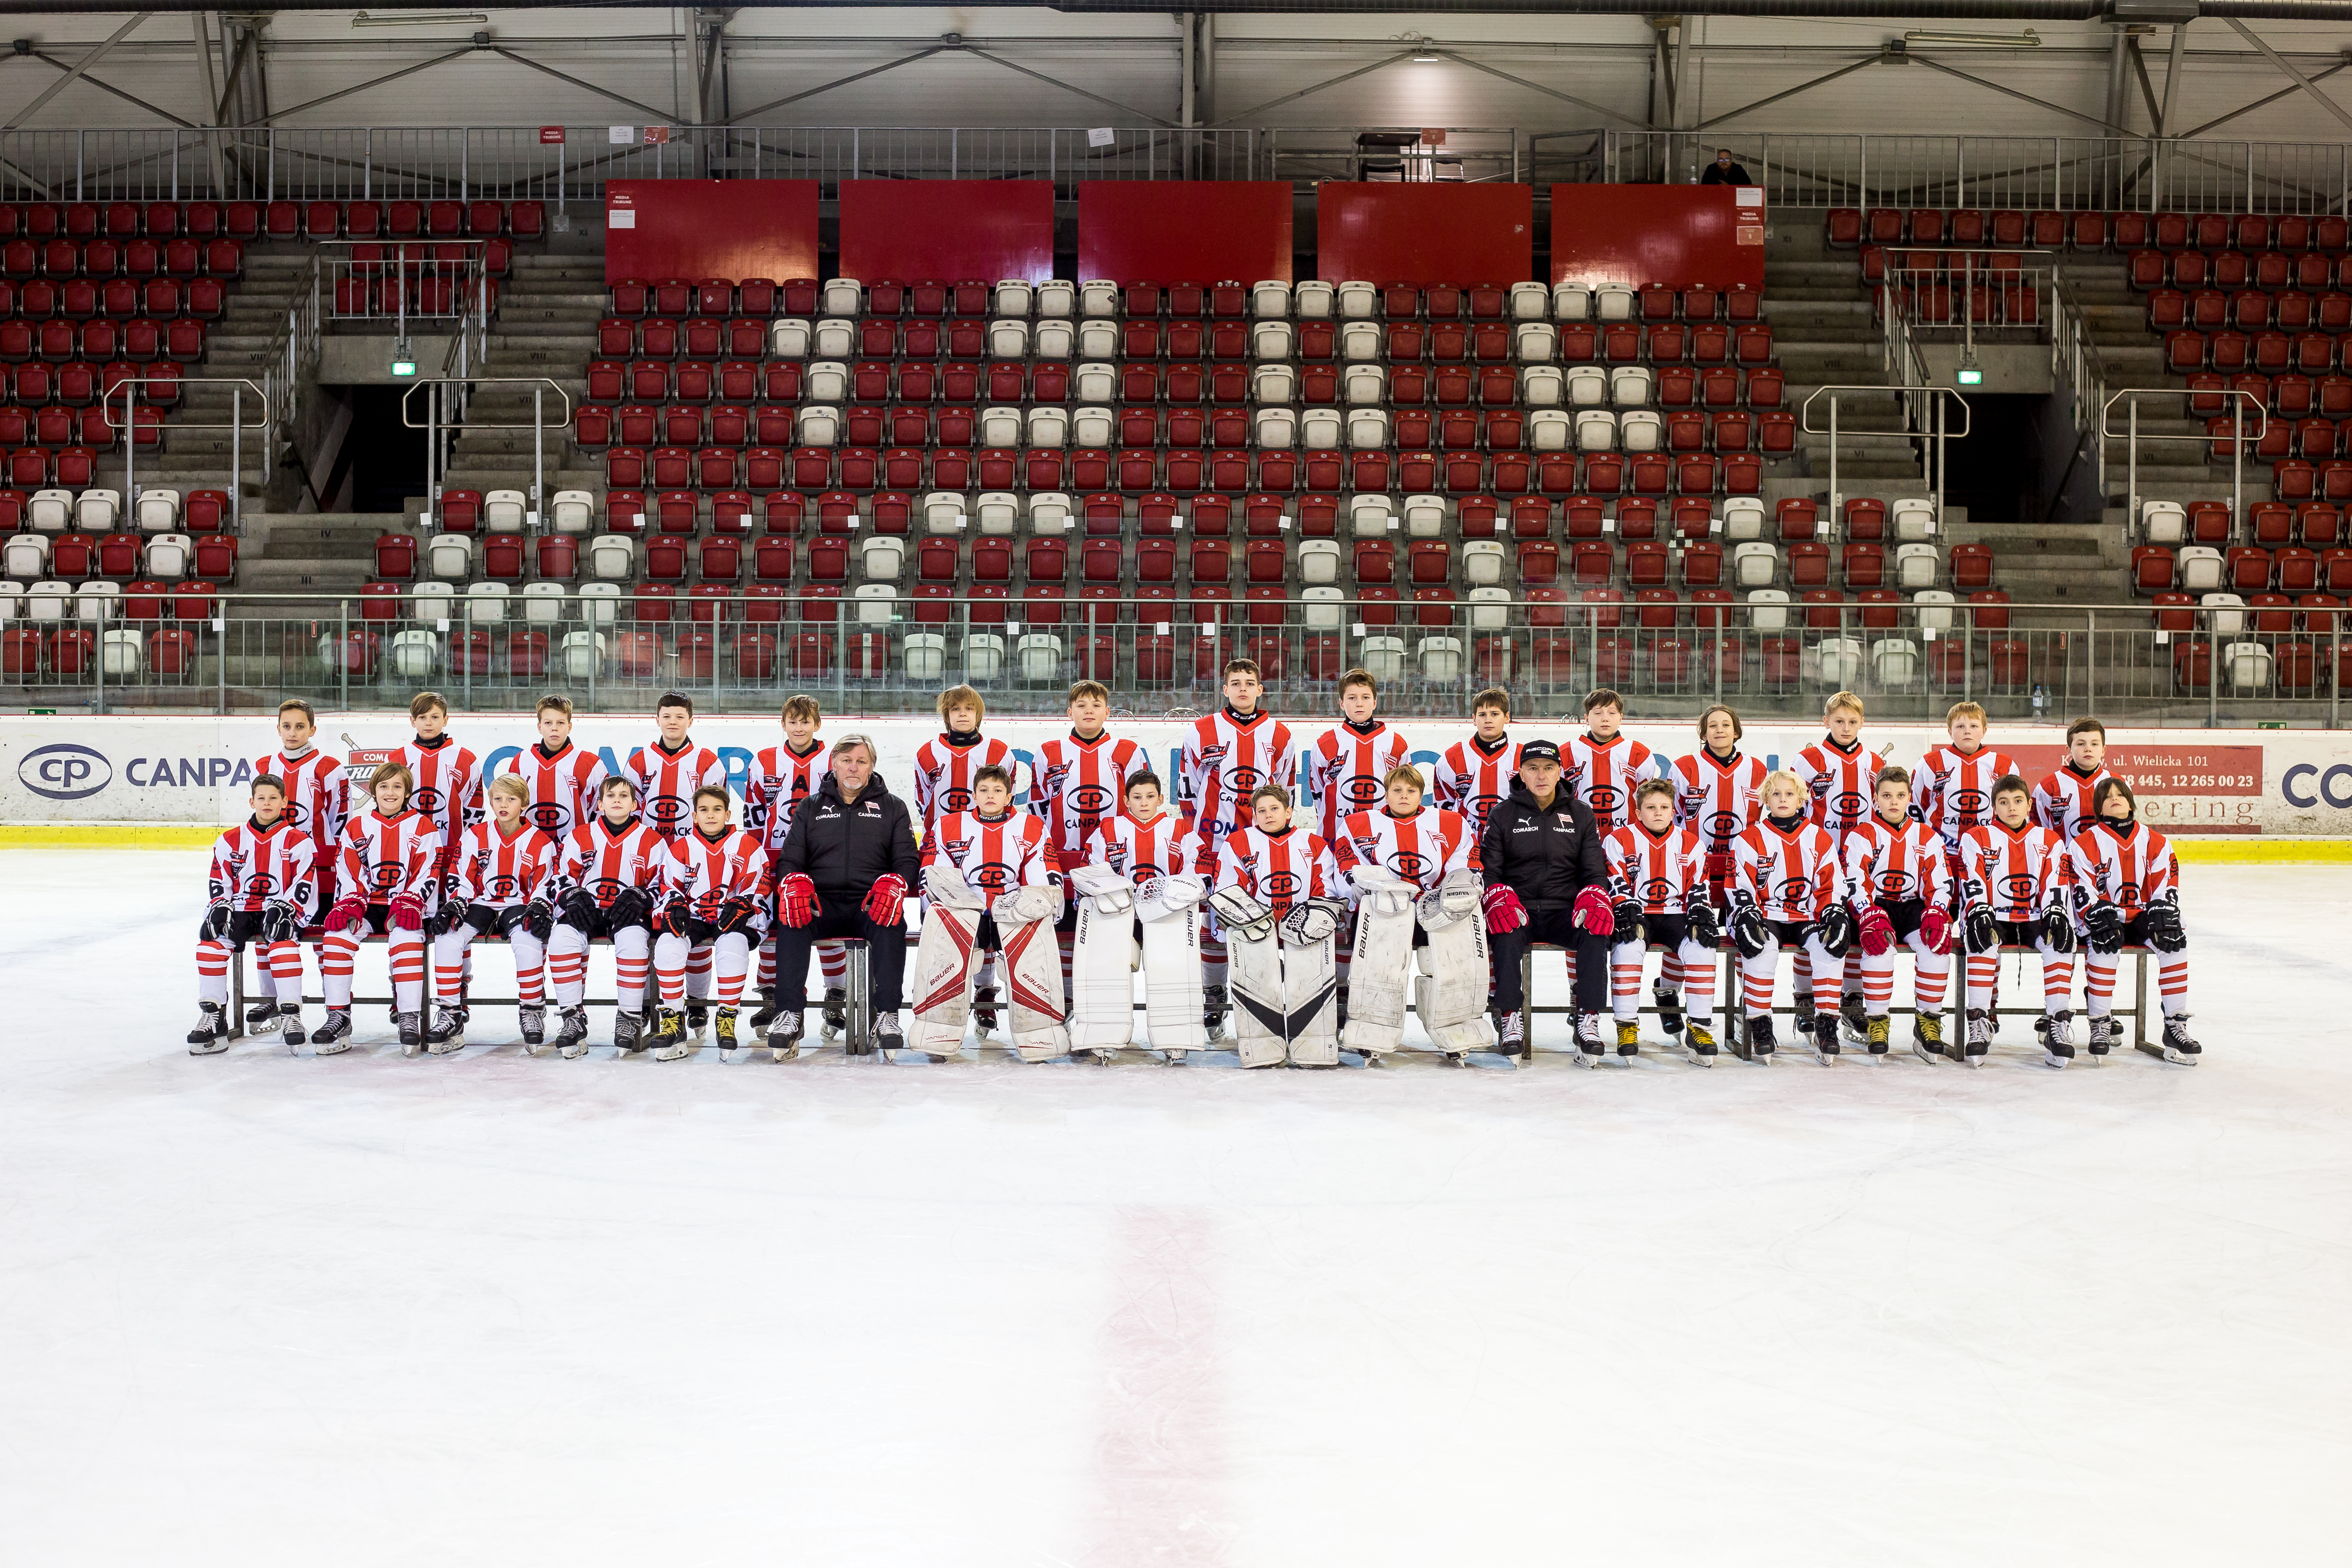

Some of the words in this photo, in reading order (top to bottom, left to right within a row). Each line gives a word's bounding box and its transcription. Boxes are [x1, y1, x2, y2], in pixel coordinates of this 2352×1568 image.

[301, 576, 311, 584] III
[2113, 756, 2127, 766] ul.
[2134, 756, 2181, 766] Wielicka
[2187, 756, 2208, 767] 101
[126, 758, 253, 787] CANPA
[791, 775, 808, 792] A
[1234, 774, 1257, 788] cp
[2138, 775, 2166, 789] 445,
[2172, 775, 2187, 787] 12
[2191, 775, 2214, 787] 265
[2218, 775, 2234, 787] 00
[2238, 775, 2254, 787] 23
[1351, 783, 1376, 798] cp
[1077, 793, 1103, 808] cp
[1219, 792, 1251, 808] CANP
[1589, 793, 1615, 807] cp
[1957, 795, 1981, 809] cp
[655, 802, 680, 816] cp
[2144, 797, 2254, 825] ering
[1065, 818, 1101, 829] CANPA
[1597, 818, 1627, 827] PACK
[1824, 821, 1859, 830] CANPA
[652, 827, 692, 836] ANPACK
[1109, 852, 1128, 861] EJOWA
[1191, 859, 1212, 867] CANPA
[1758, 866, 1775, 874] EJOWA
[209, 879, 224, 900] 6
[1172, 879, 1197, 889] BAUER
[1269, 877, 1292, 892] cp
[294, 882, 312, 904] 6
[1080, 909, 1089, 944] BAUER
[1802, 923, 1821, 934] BAU
[1359, 913, 1370, 959] BAUER
[1472, 914, 1484, 959] BAUER
[930, 963, 955, 986] BAUER
[1022, 974, 1049, 994] BAUER
